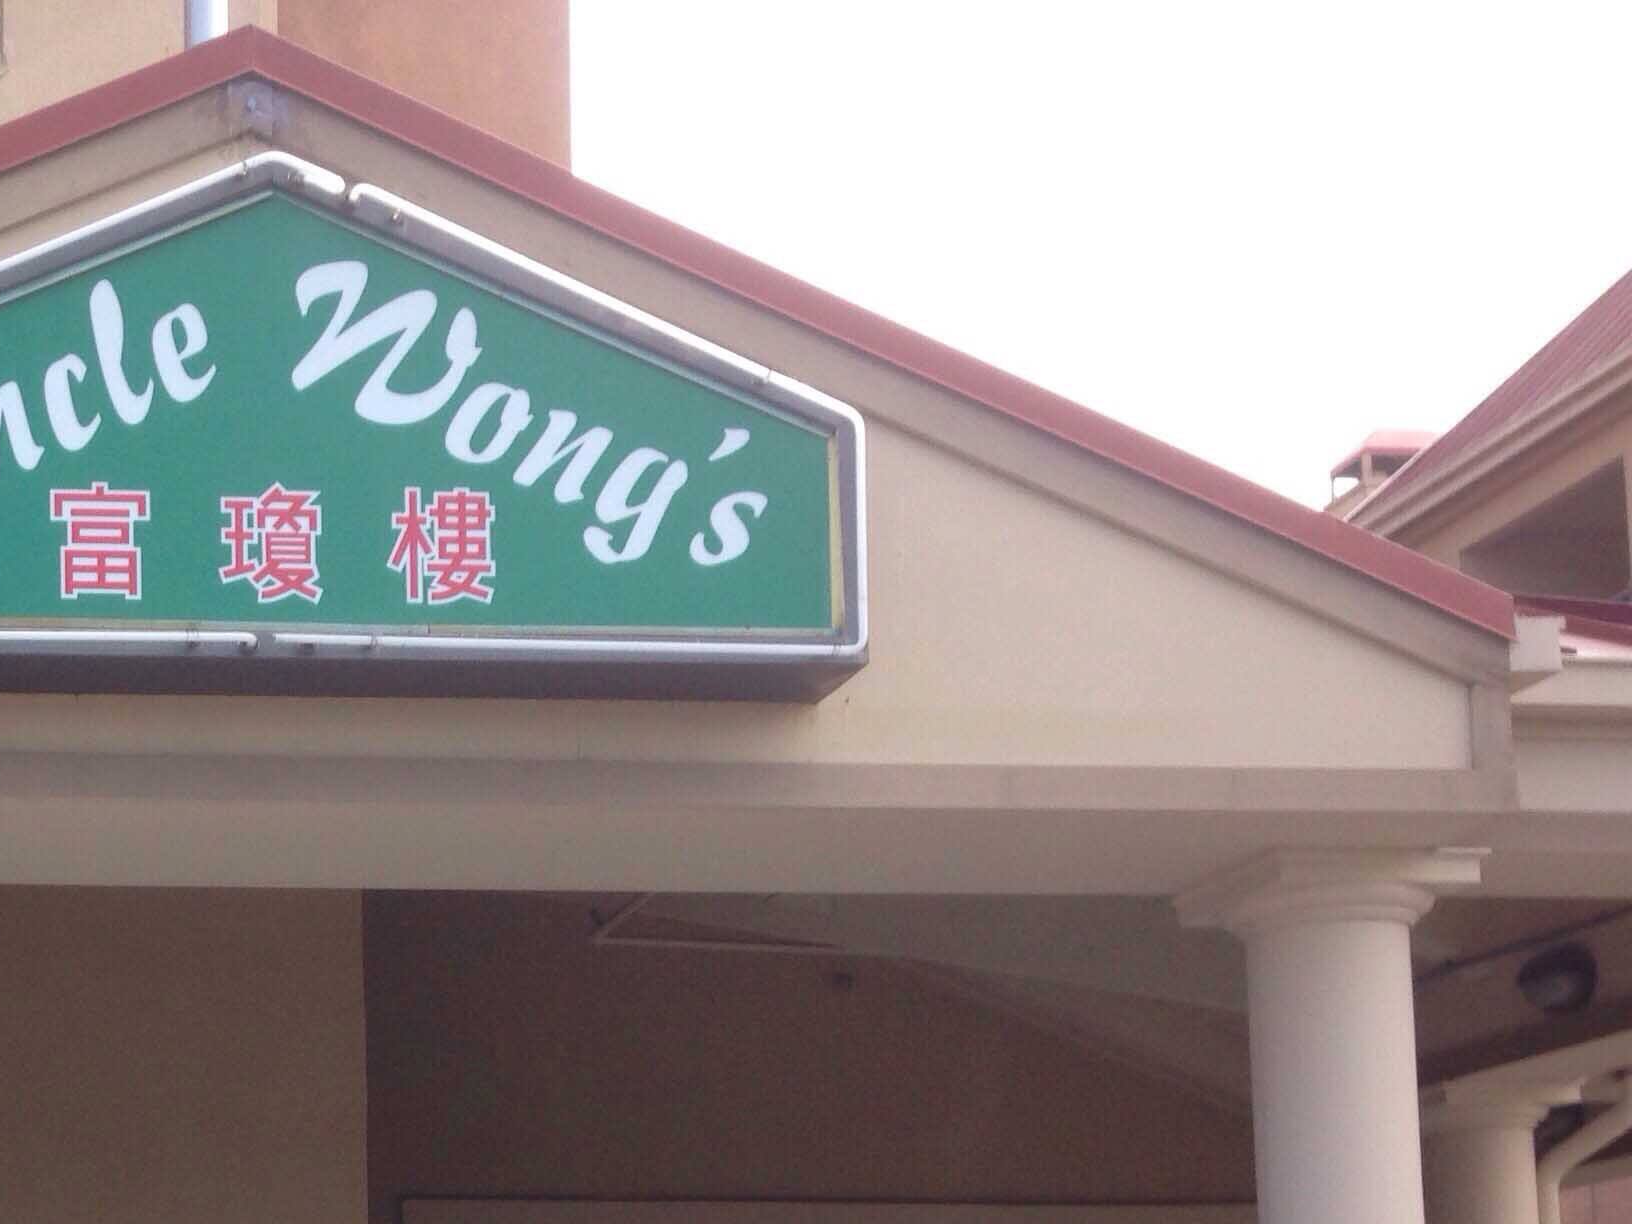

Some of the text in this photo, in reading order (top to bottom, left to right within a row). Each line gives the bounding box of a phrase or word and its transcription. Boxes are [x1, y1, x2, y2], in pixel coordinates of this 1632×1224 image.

[291, 259, 768, 567] Wong's
[48, 481, 497, 604] 富瓊樓
